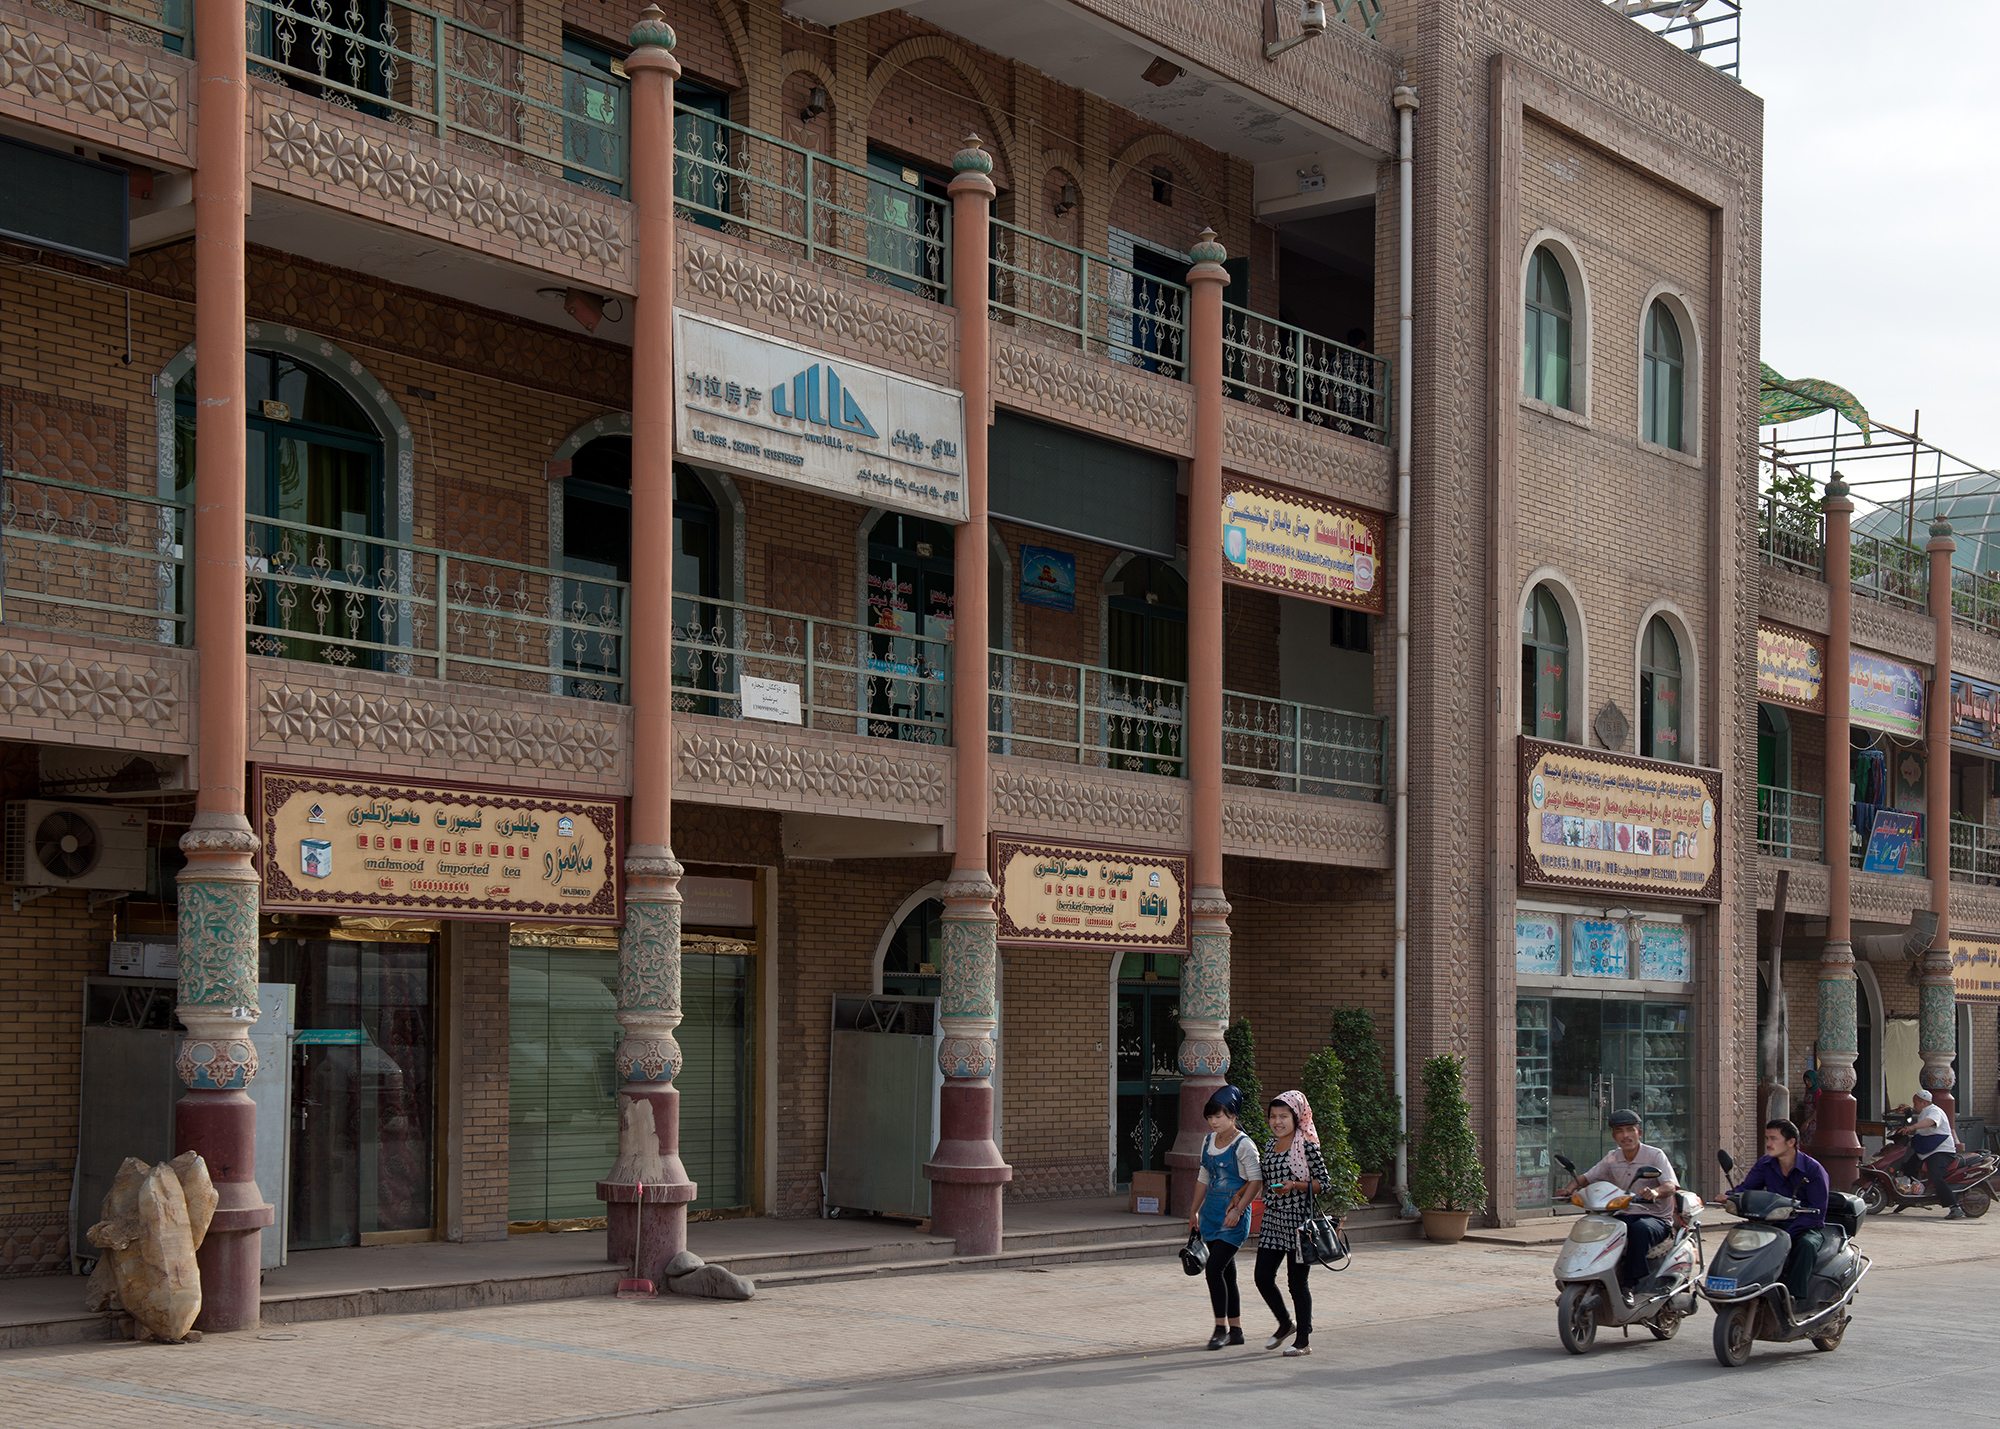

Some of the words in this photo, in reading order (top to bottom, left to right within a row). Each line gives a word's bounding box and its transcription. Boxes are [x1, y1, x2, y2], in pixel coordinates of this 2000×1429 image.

[687, 371, 762, 408] 力拉房产
[366, 858, 425, 871] mahmood
[439, 861, 490, 875] imported
[504, 866, 521, 877] tea
[380, 877, 394, 888] tel:
[413, 880, 469, 891] 18609988644
[562, 888, 591, 896] MAHMOOD
[1083, 902, 1114, 914] imported
